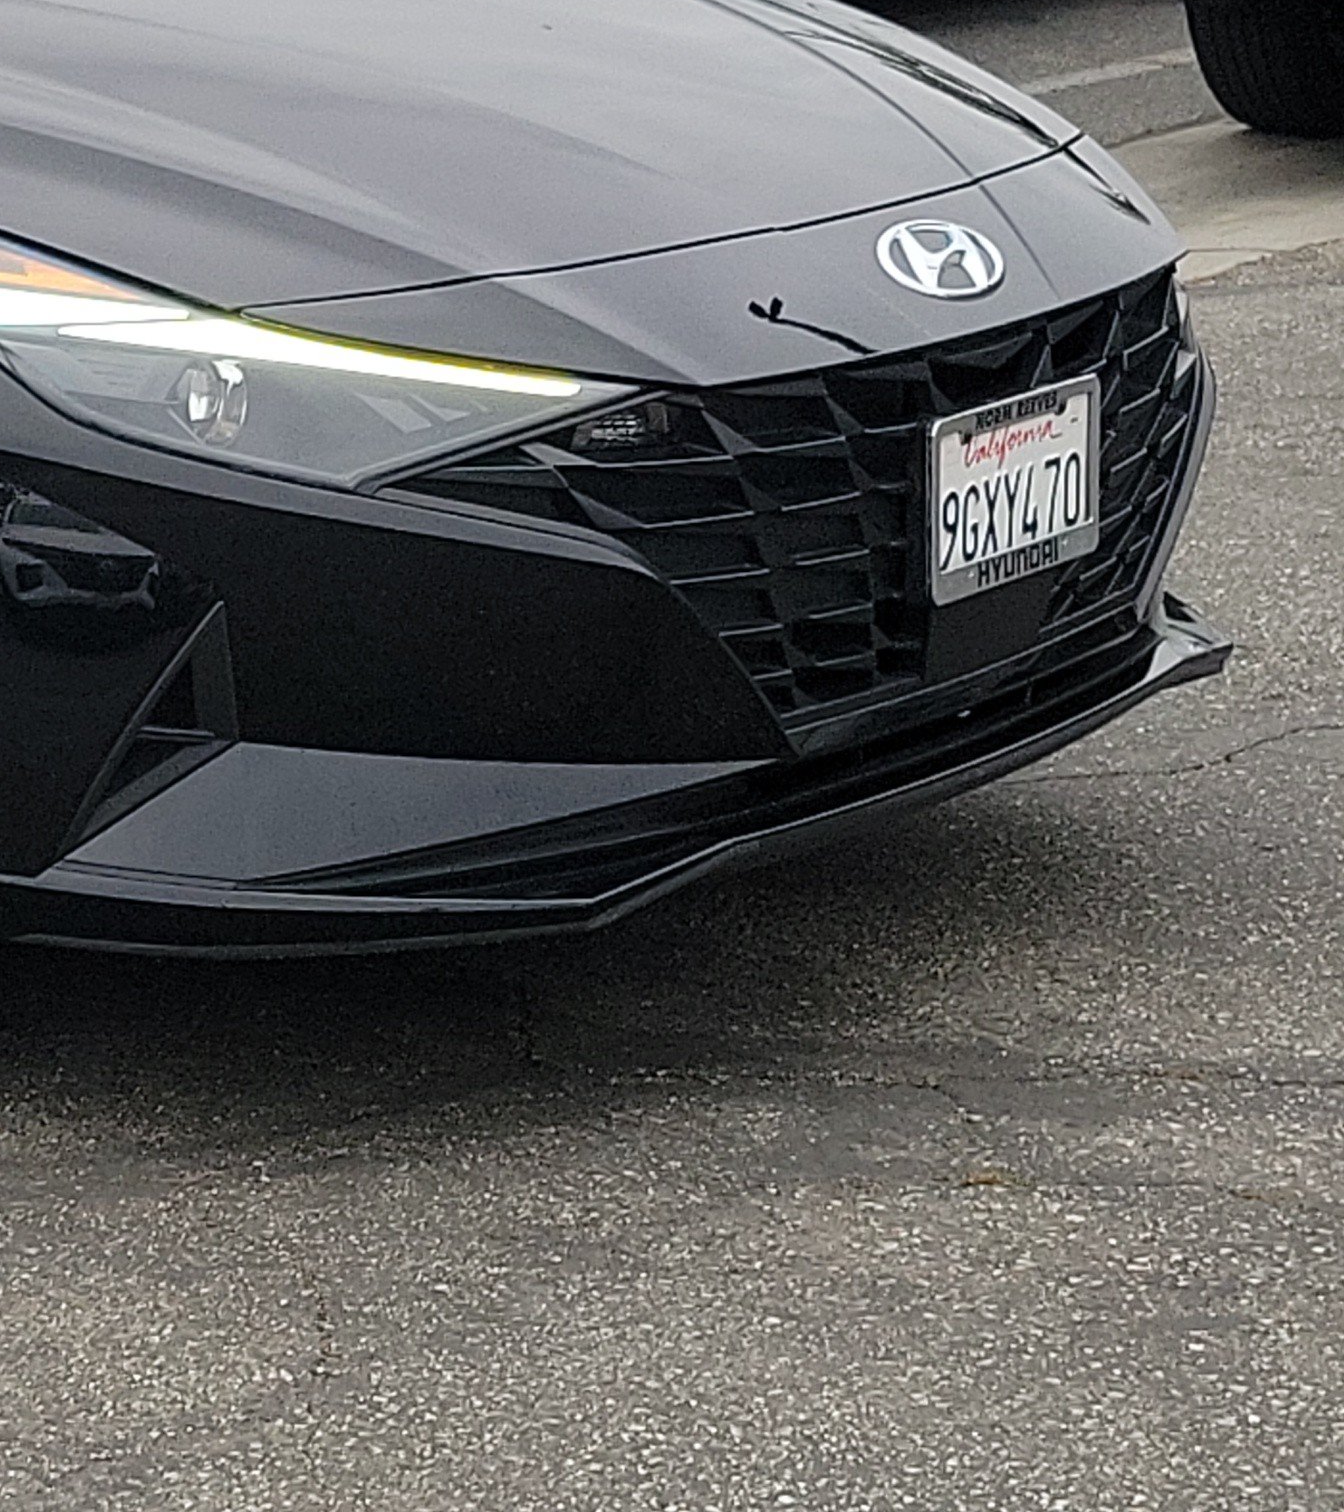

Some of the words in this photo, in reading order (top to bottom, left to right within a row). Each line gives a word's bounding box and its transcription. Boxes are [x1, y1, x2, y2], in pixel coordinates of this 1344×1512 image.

[962, 419, 1063, 470] California
[939, 451, 1081, 571] 9GXY470
[977, 537, 1059, 587] HYUNDAI
